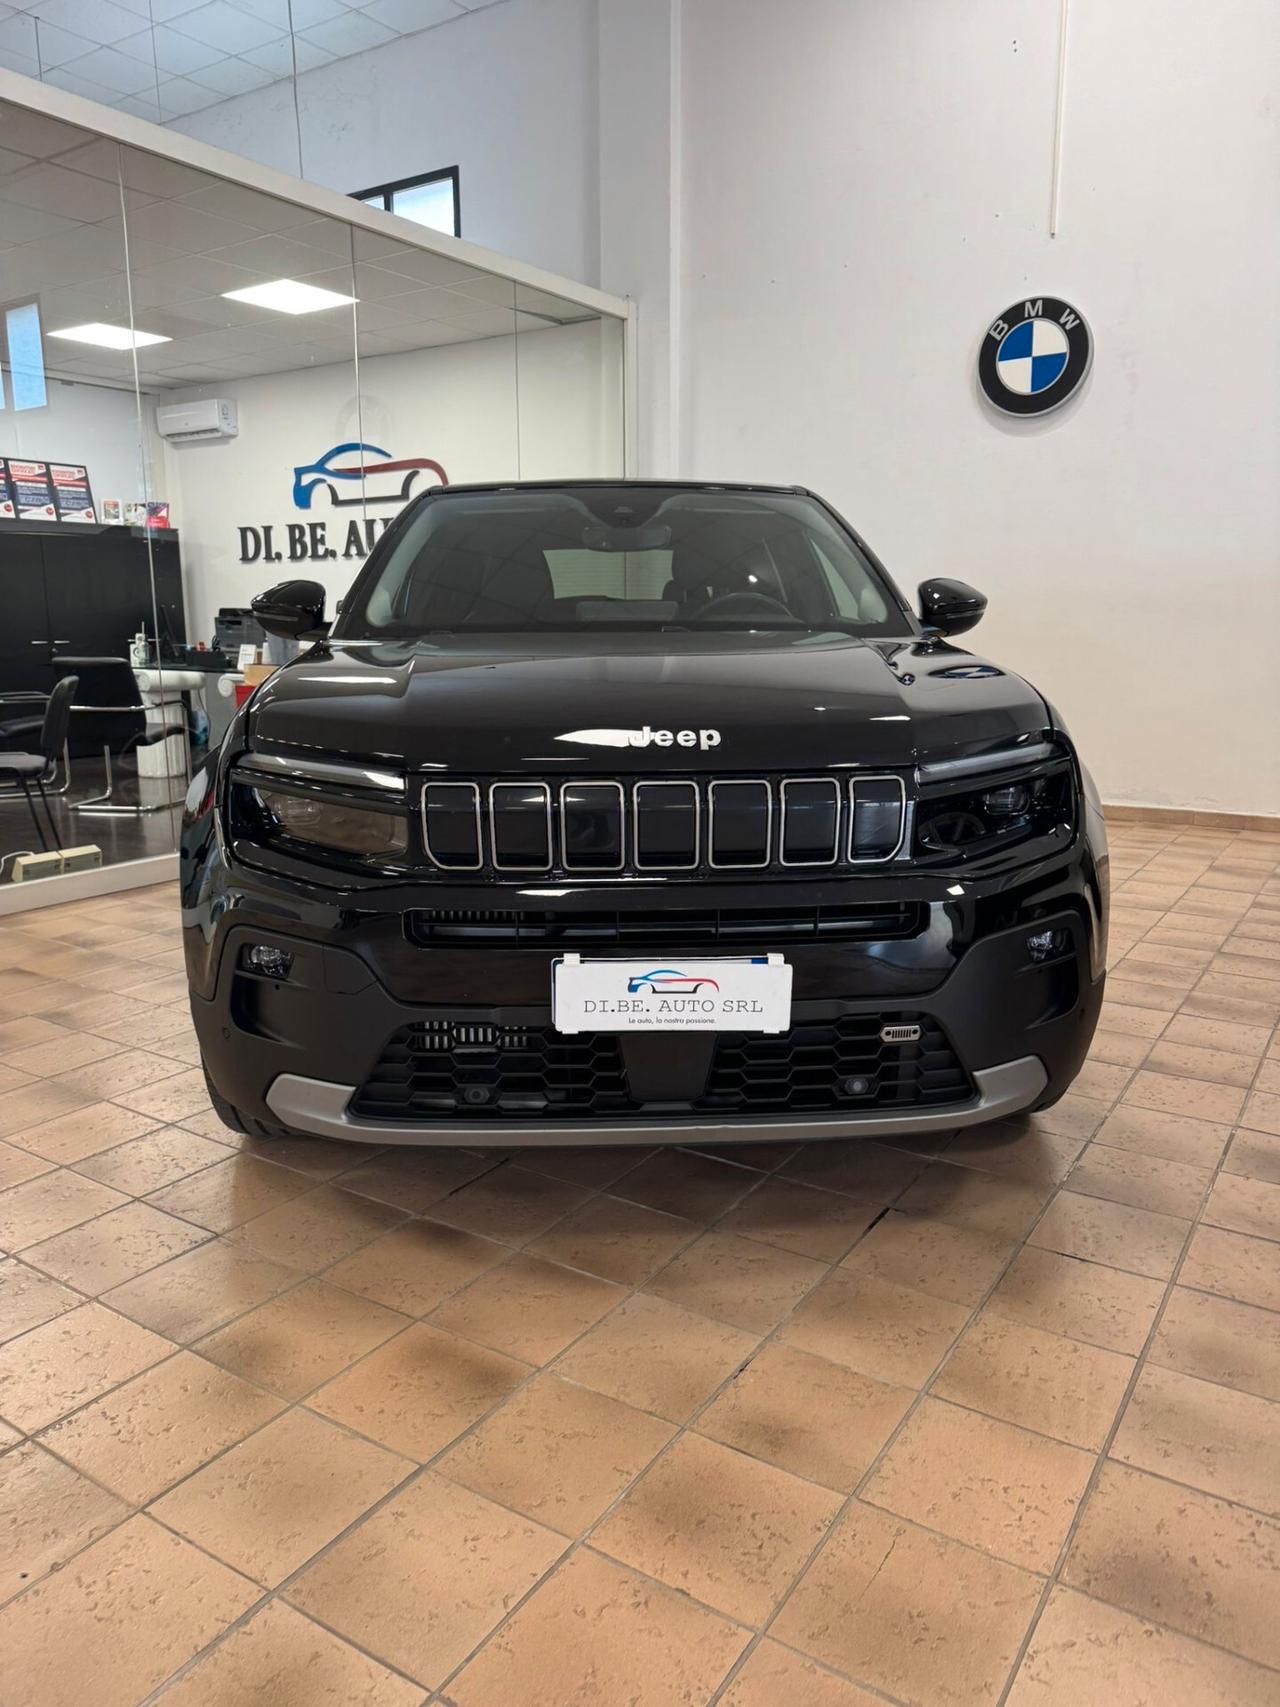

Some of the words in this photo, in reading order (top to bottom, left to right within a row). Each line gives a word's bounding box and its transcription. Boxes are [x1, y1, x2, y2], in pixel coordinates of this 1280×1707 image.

[988, 299, 1080, 341] BMW
[628, 726, 721, 750] Jeep
[658, 1000, 715, 1012] AUTO
[722, 1000, 763, 1012] SRL
